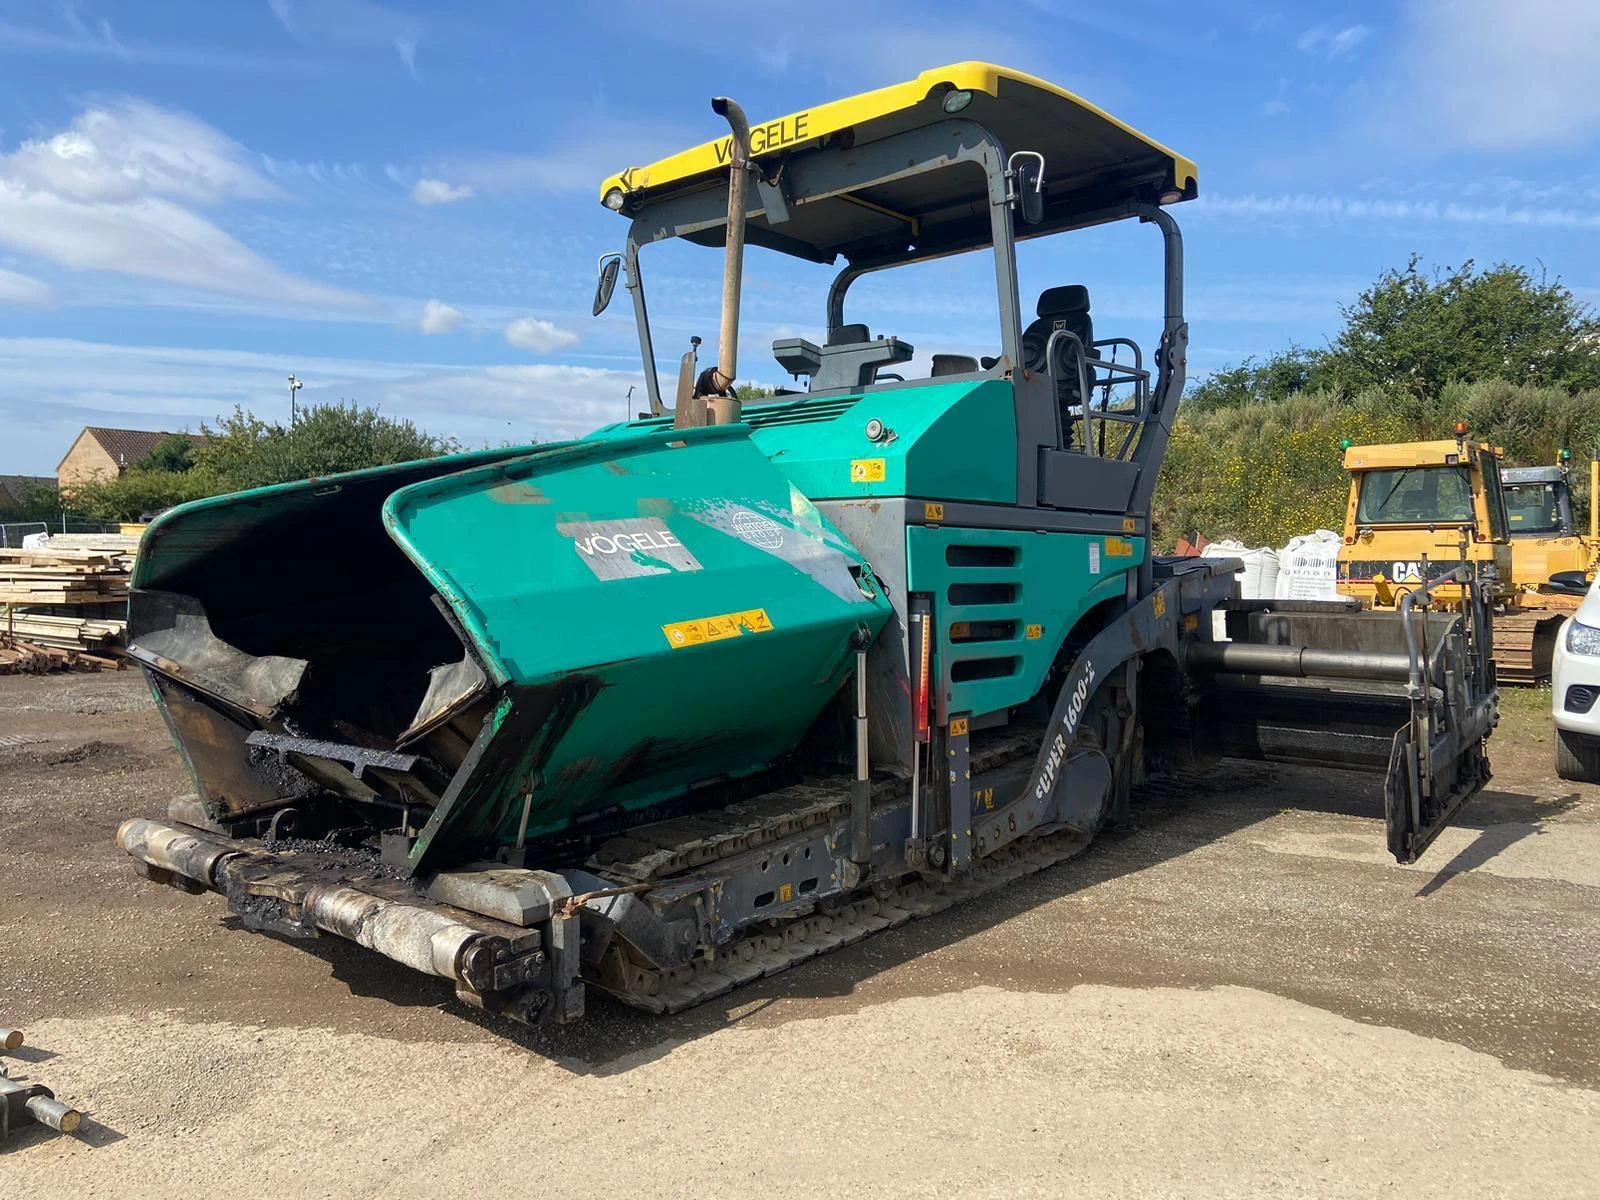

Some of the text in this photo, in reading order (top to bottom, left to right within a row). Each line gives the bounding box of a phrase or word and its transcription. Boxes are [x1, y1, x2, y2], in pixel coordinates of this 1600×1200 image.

[714, 113, 809, 163] VGELE
[731, 520, 778, 532] WIRTGEN
[742, 529, 781, 540] GROUP
[575, 529, 682, 555] VÖGELE
[1036, 733, 1067, 799] SUPER
